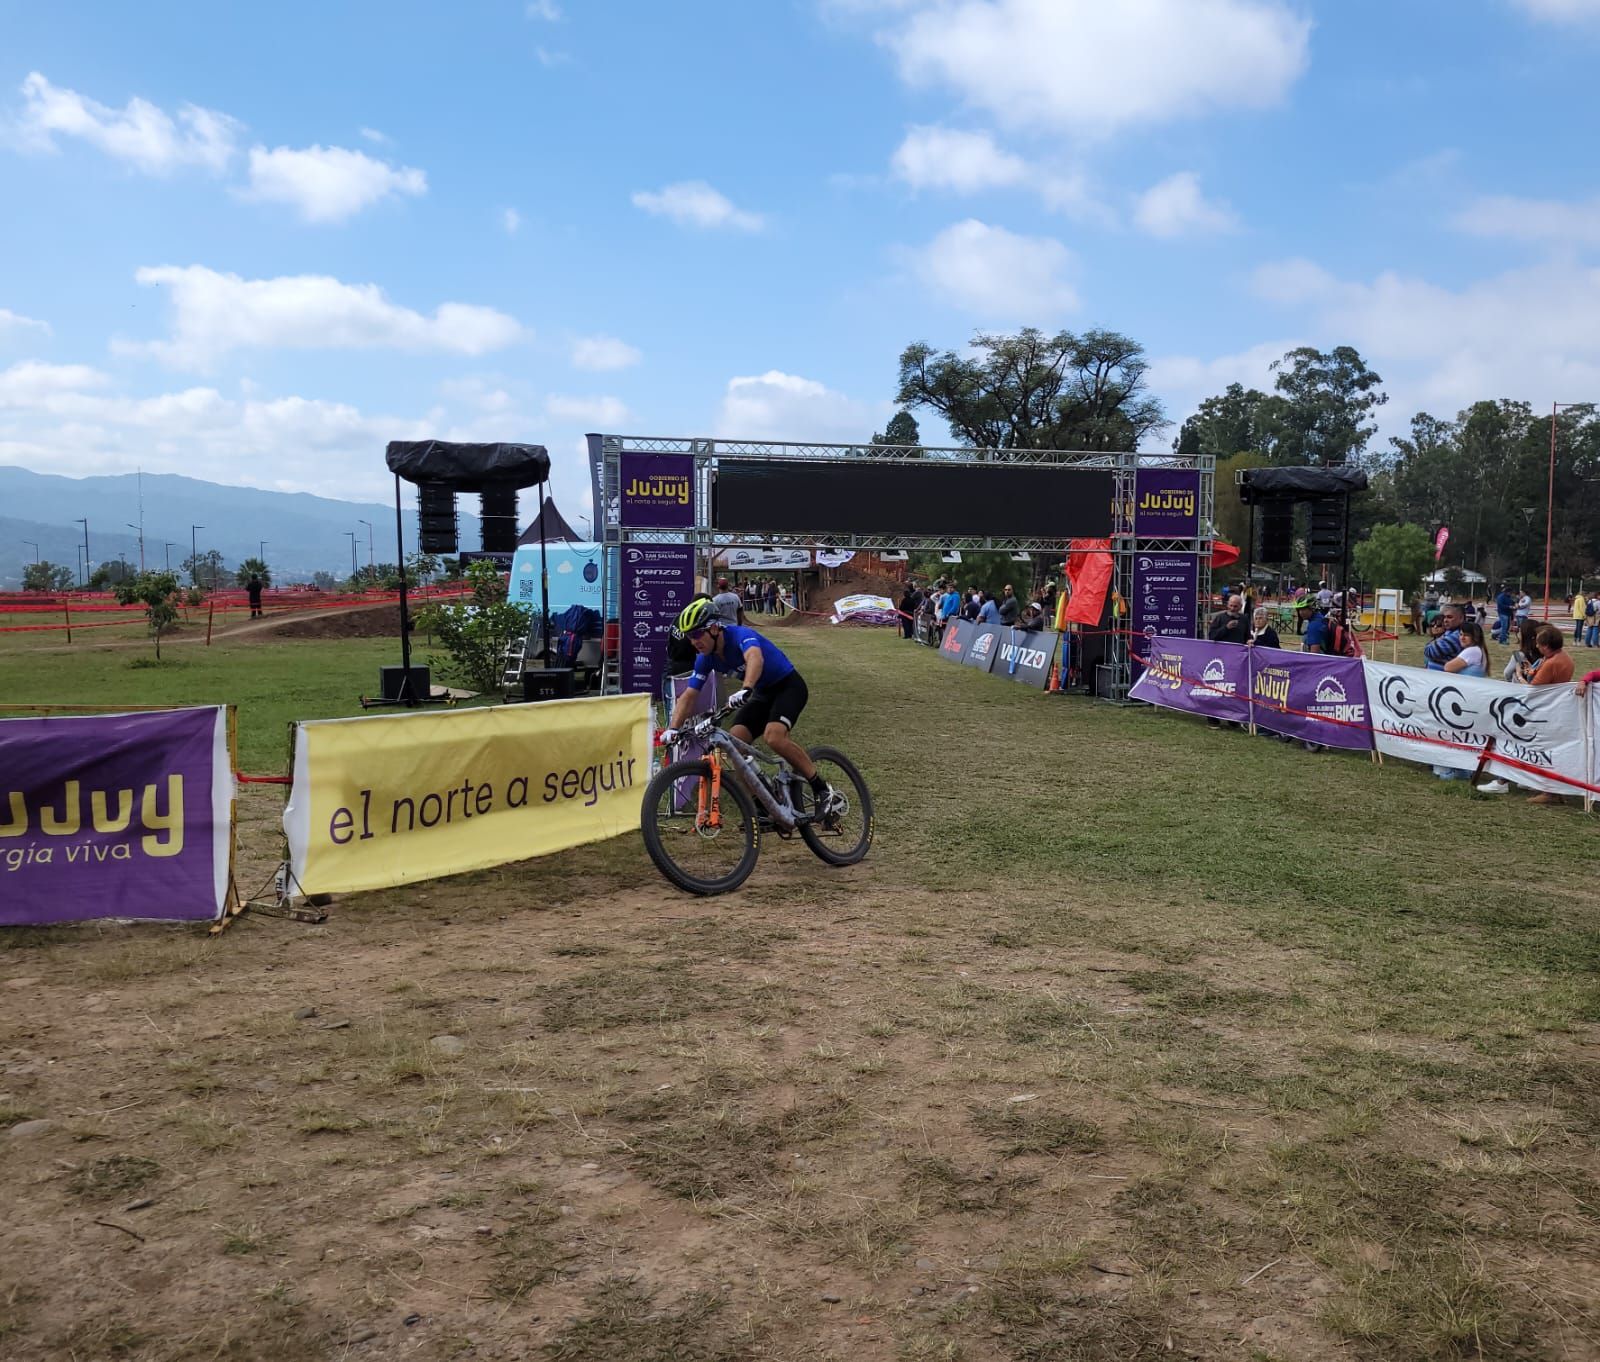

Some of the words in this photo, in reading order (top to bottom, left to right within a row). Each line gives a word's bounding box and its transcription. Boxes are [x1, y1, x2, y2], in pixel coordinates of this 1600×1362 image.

[1335, 704, 1365, 722] BIKE
[1438, 729, 1496, 748] CAZO
[329, 789, 374, 845] el
[390, 778, 493, 834] norte
[506, 776, 529, 808] a
[542, 750, 636, 807] seguir
[65, 840, 132, 863] viva
